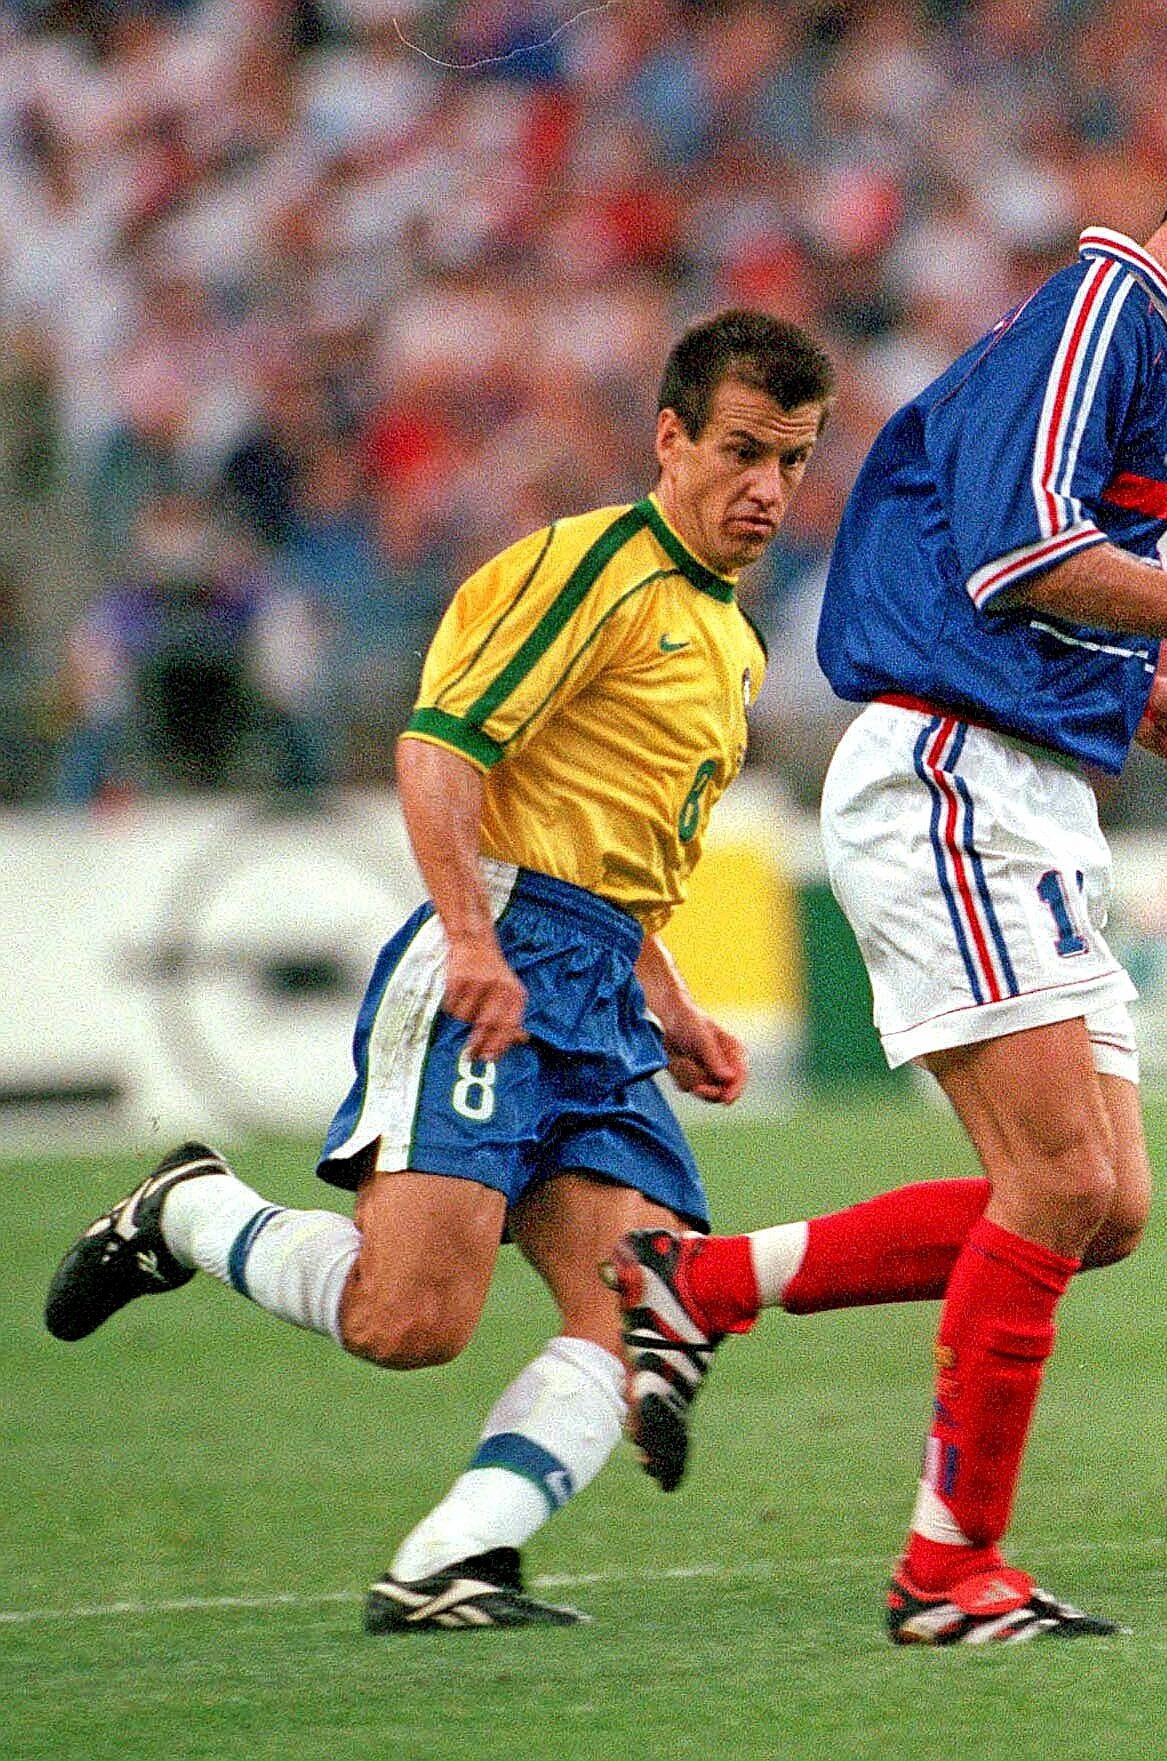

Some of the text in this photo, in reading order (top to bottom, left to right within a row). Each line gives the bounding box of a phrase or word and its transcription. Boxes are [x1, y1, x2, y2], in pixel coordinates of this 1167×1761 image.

[678, 759, 717, 844] 8
[1037, 868, 1089, 958] 1
[452, 1046, 496, 1121] 8
